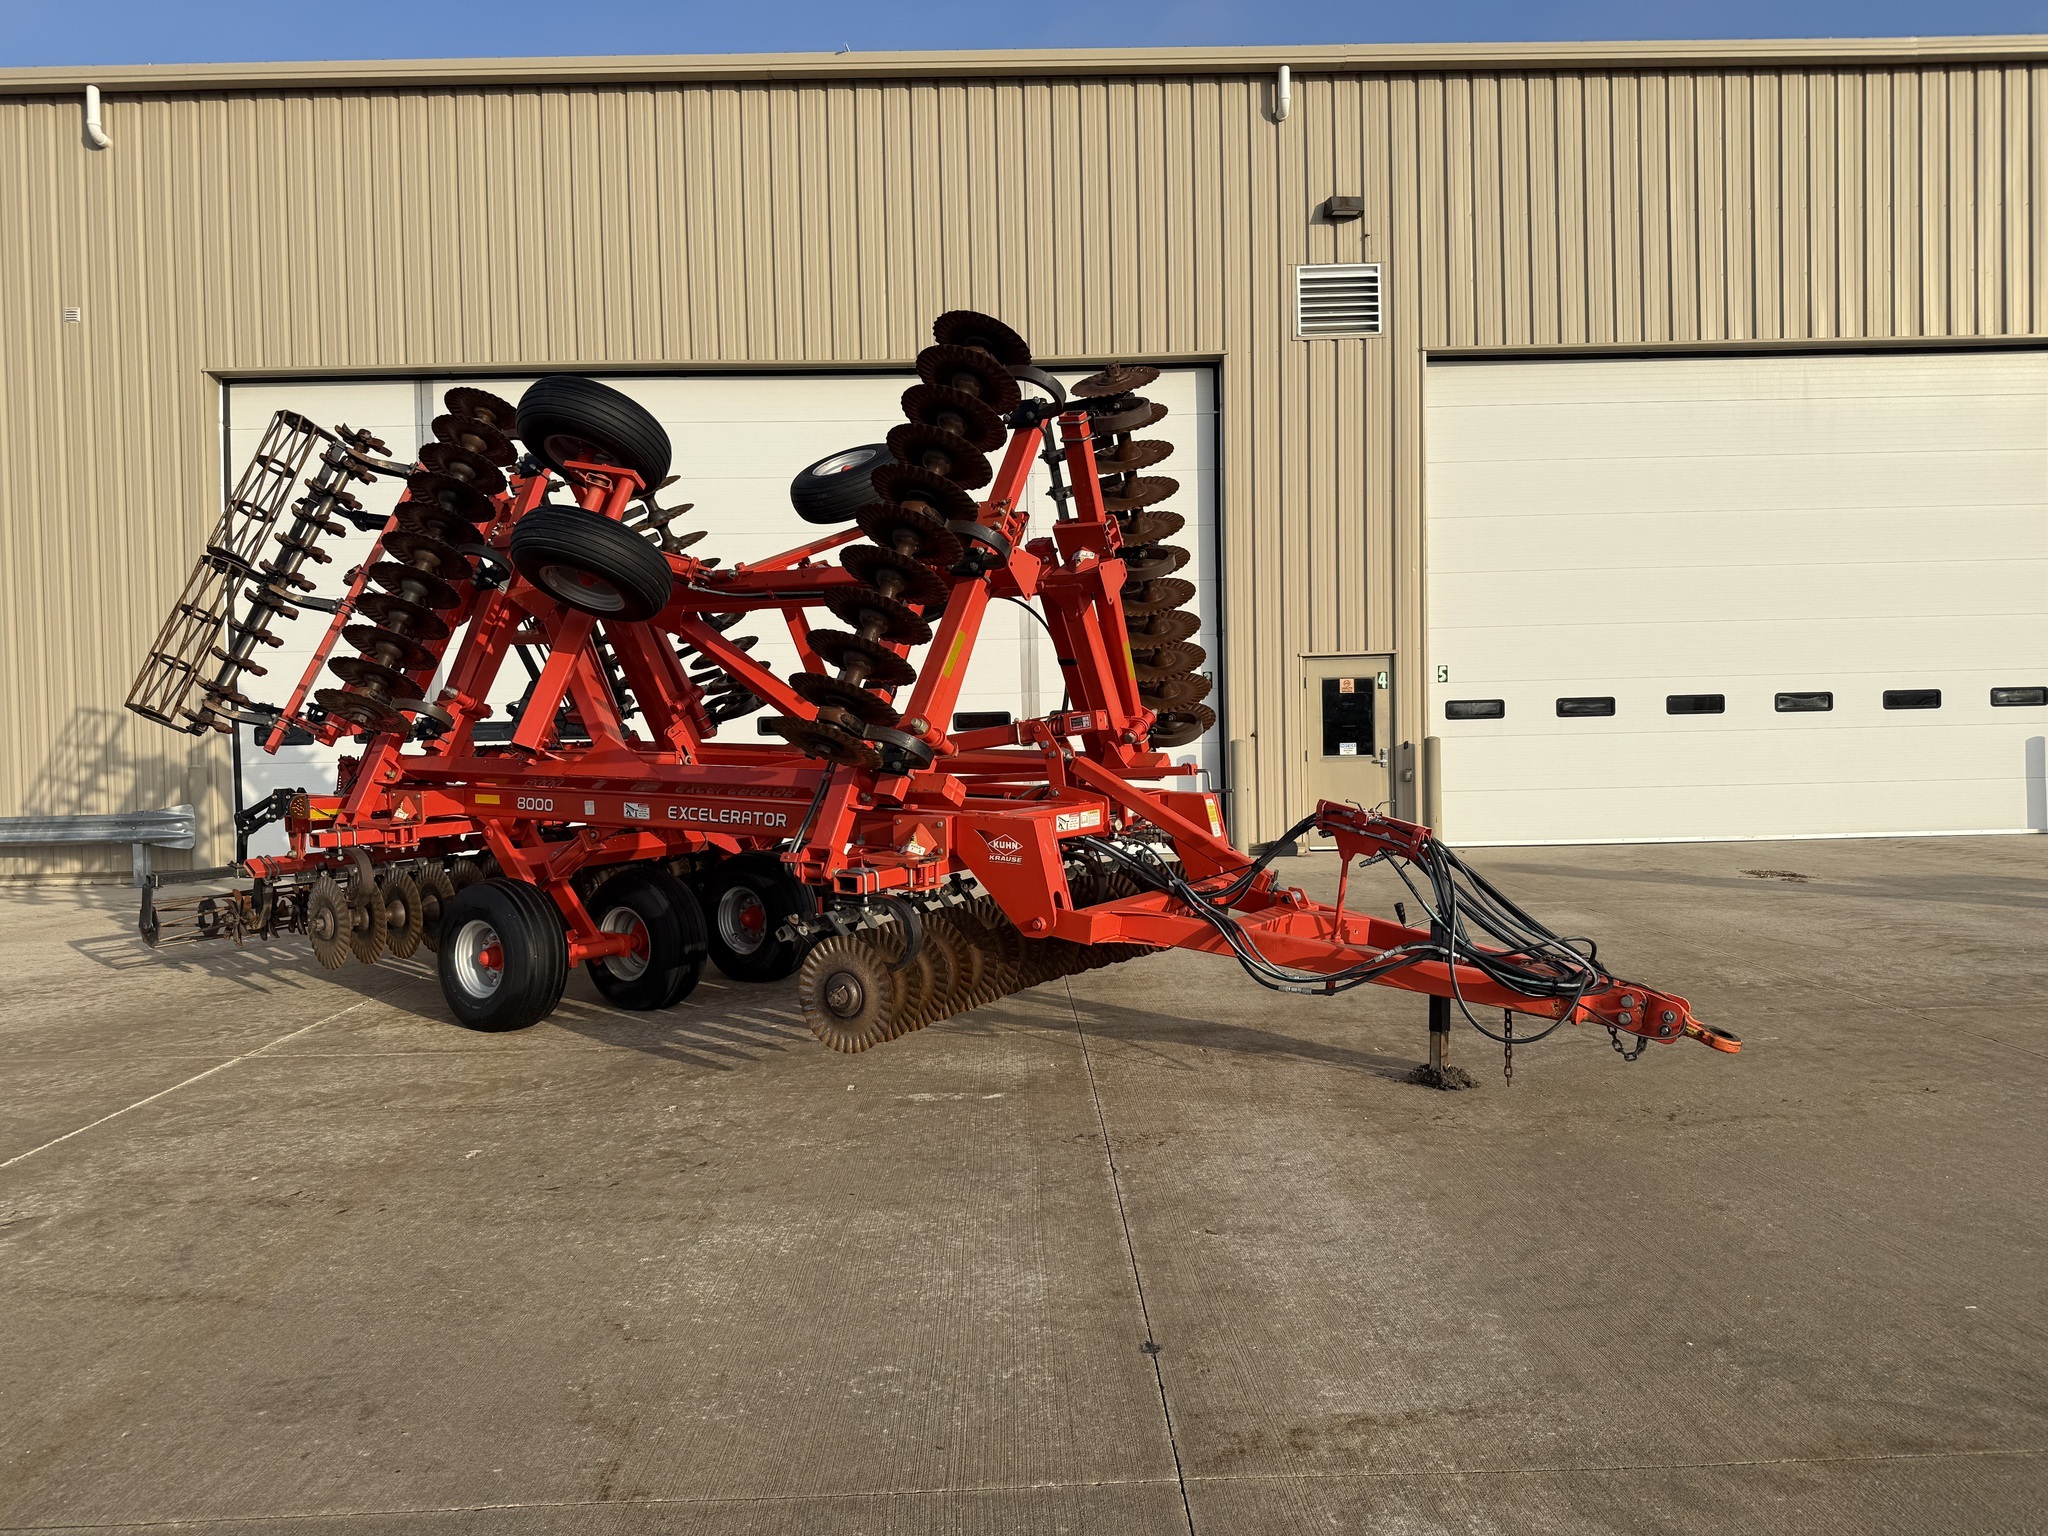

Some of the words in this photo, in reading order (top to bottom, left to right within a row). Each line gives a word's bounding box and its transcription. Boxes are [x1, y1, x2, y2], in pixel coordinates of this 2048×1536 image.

[1378, 672, 1387, 689] 4
[1438, 665, 1447, 682] 5
[517, 796, 554, 812] 8000
[667, 805, 787, 827] EXCELERATOR
[993, 840, 1018, 850] KUHN
[989, 854, 1022, 864] KRAUSE
